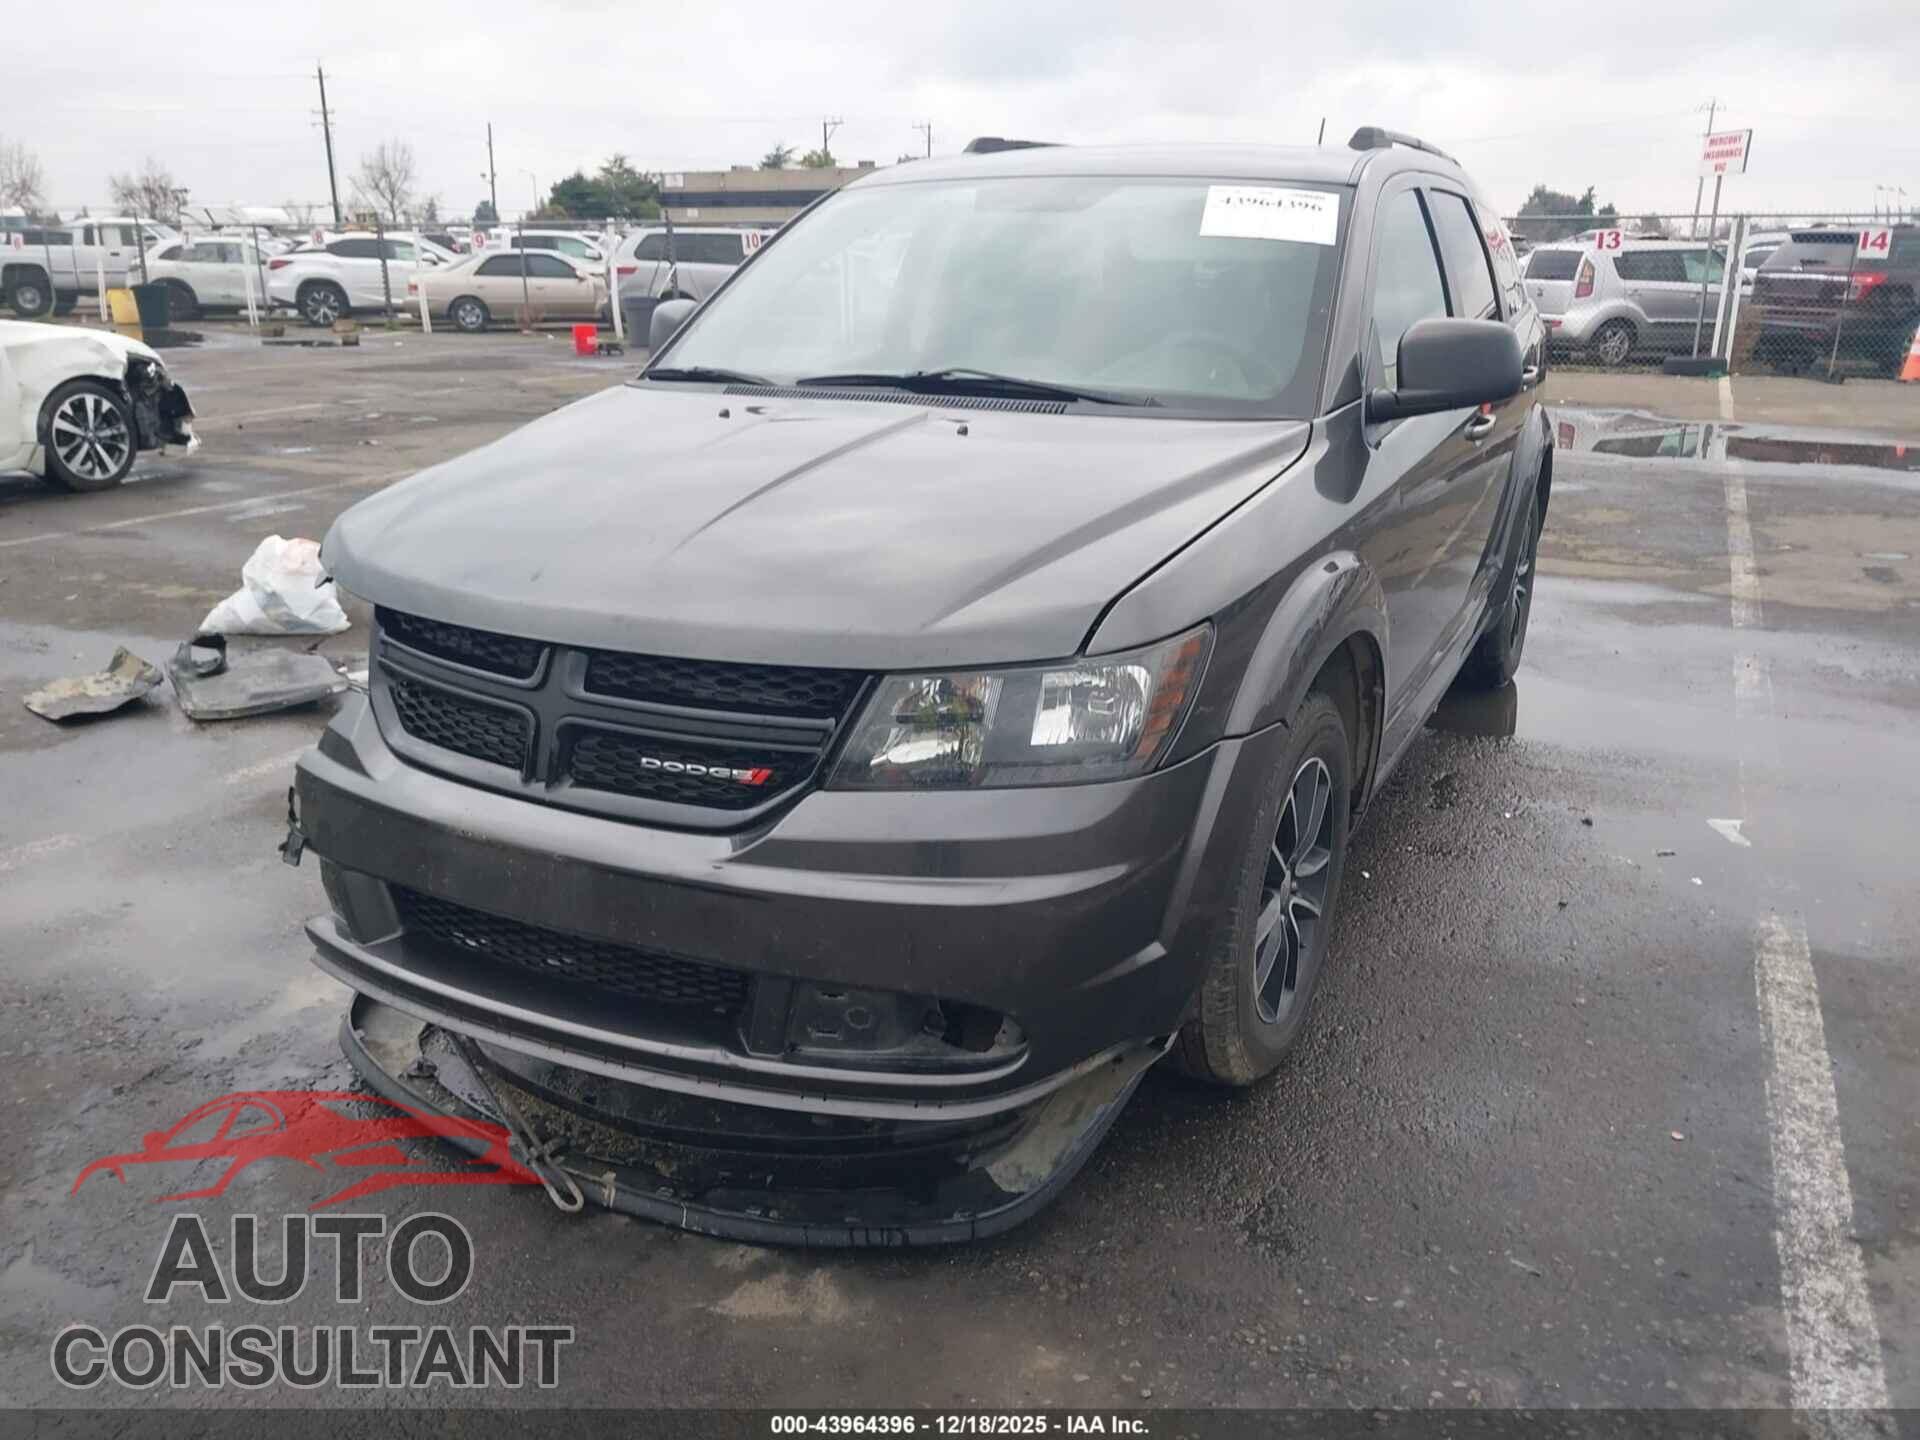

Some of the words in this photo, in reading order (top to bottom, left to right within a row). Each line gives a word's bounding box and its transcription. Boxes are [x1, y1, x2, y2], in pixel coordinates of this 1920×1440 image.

[1703, 147, 1743, 160] INSURANCE
[475, 234, 484, 248] 9
[745, 232, 760, 249] 10
[1597, 231, 1621, 249] 13
[1860, 231, 1888, 250] 14
[640, 757, 753, 781] DODGE
